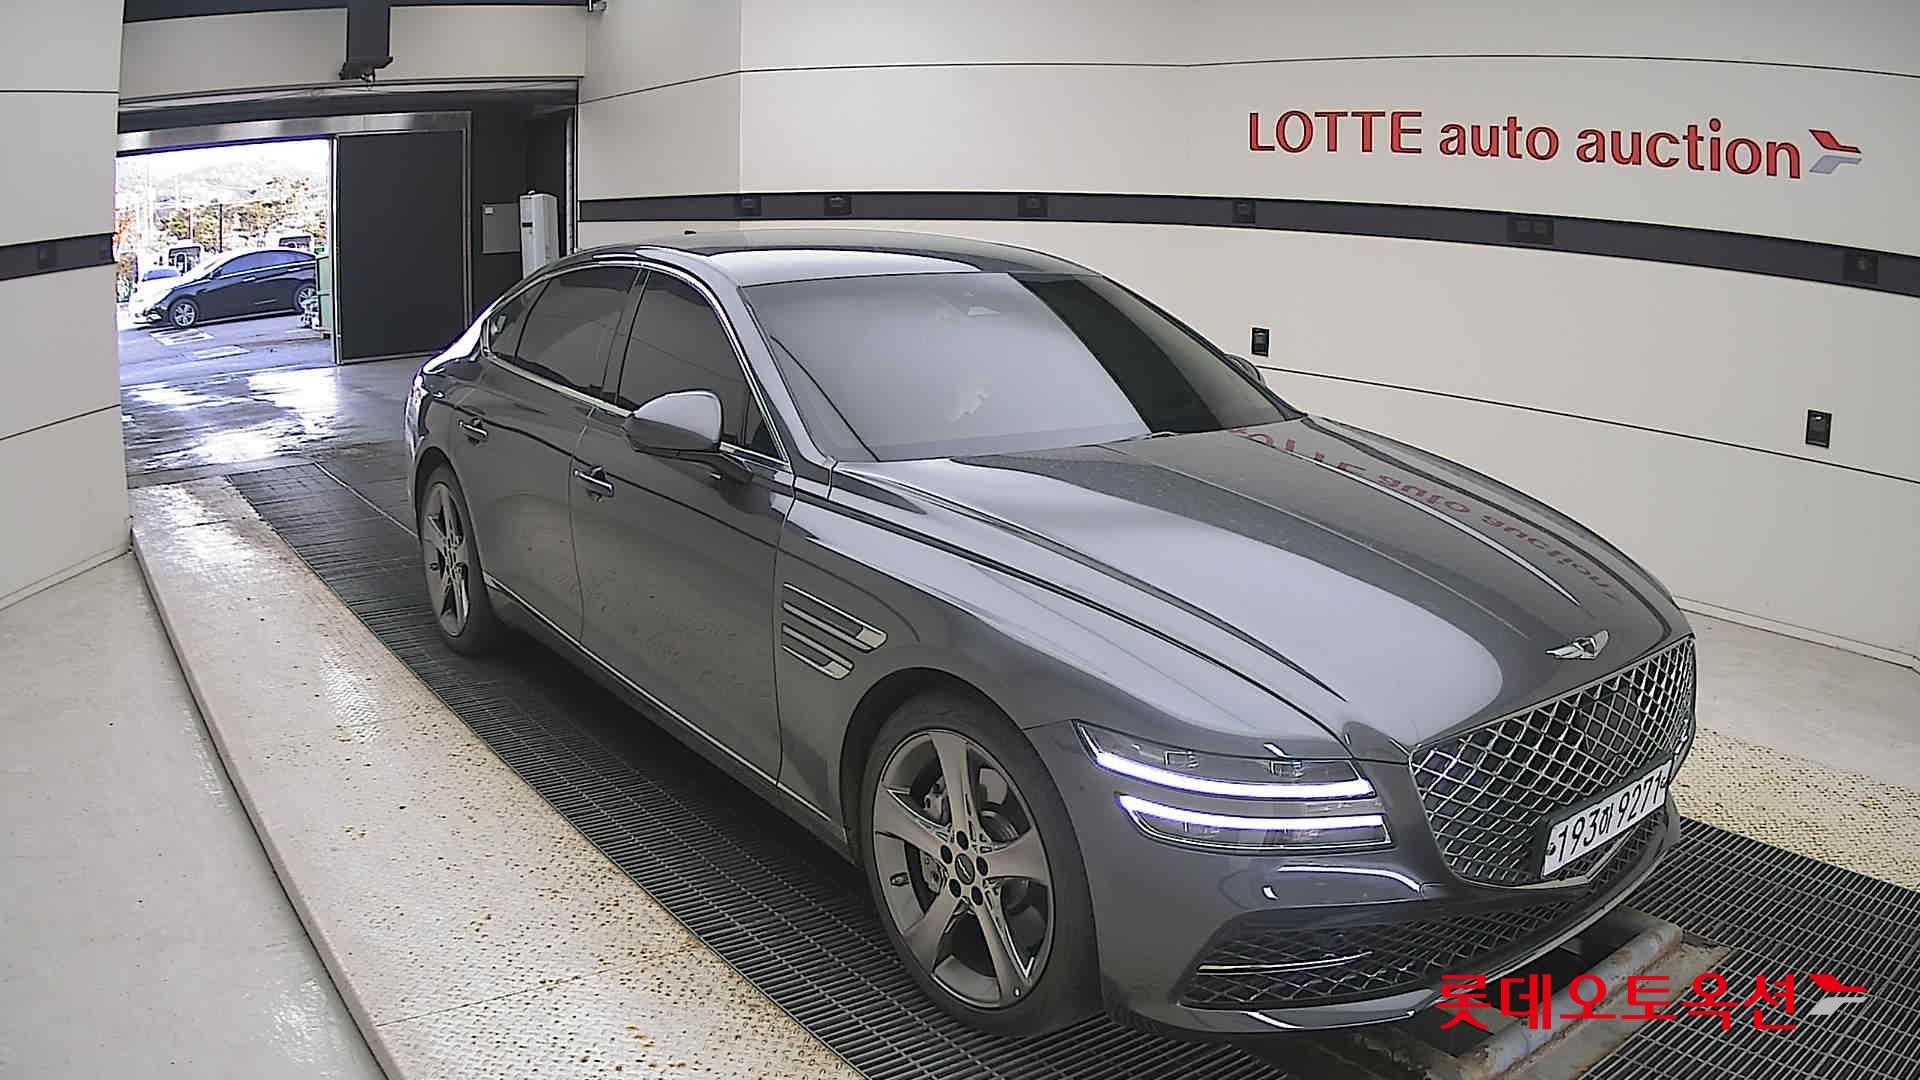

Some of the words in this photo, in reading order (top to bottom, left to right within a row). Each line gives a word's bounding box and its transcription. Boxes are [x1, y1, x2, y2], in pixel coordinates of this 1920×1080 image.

[1249, 111, 1423, 154] LOTTE
[1439, 116, 1560, 160] auto
[1577, 118, 1801, 179] auction
[1617, 769, 1662, 829] 9271
